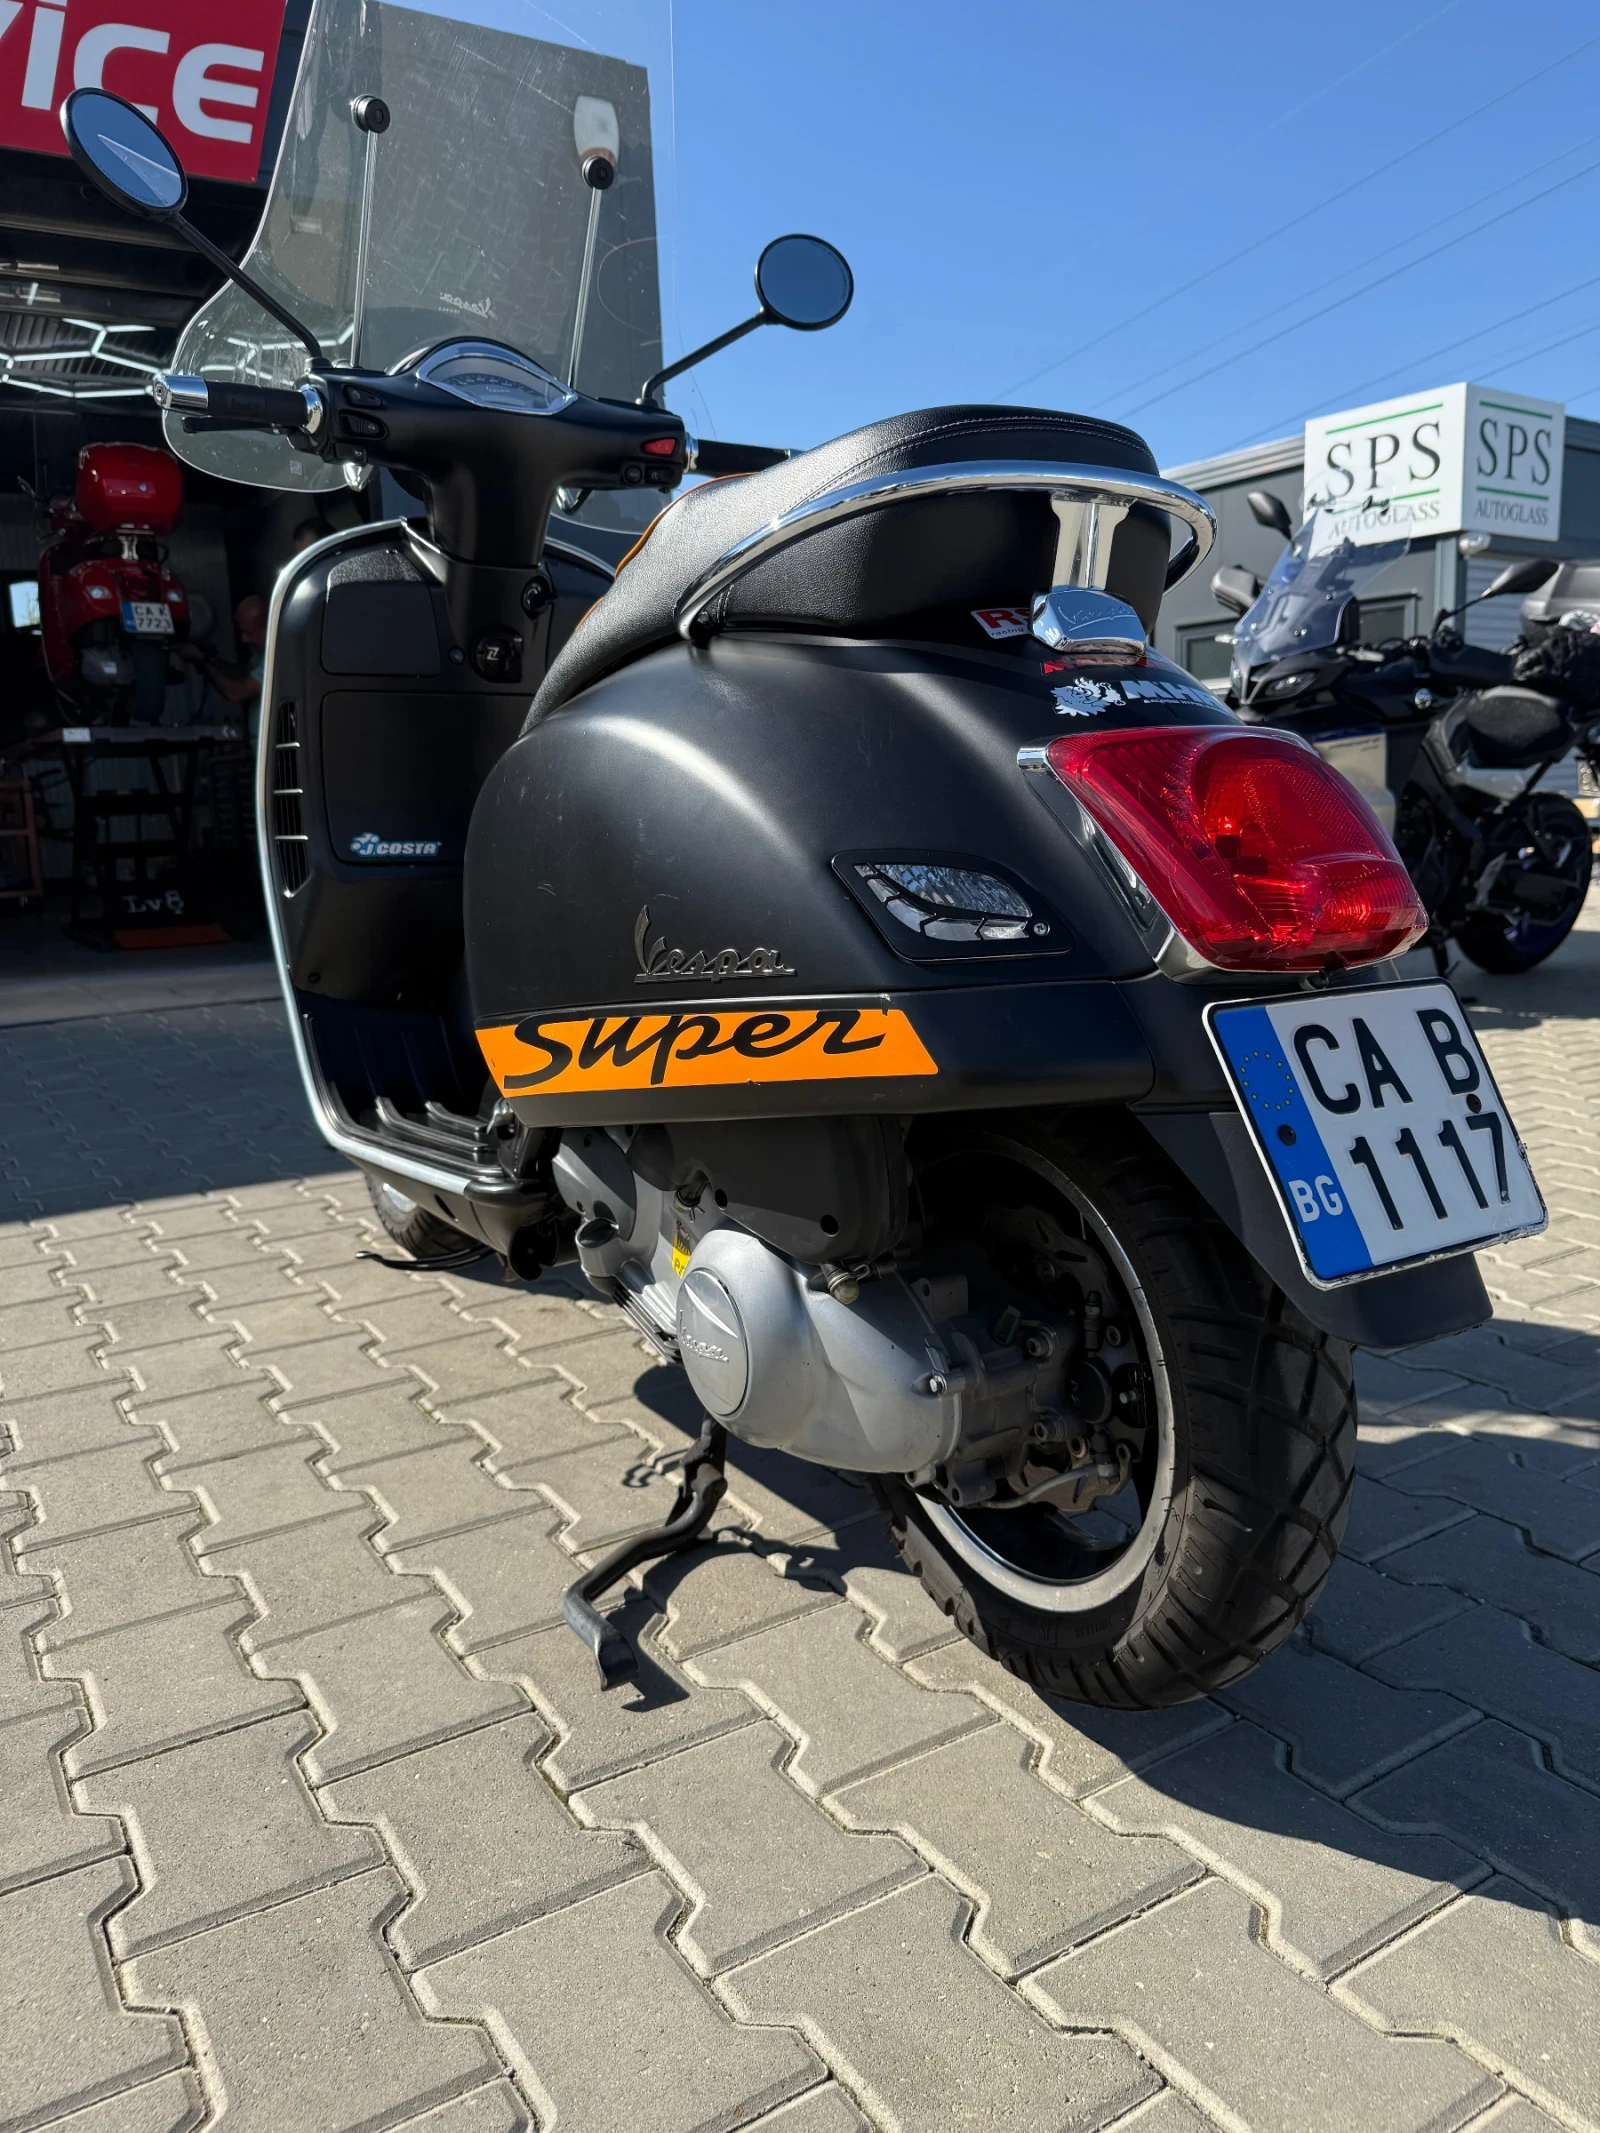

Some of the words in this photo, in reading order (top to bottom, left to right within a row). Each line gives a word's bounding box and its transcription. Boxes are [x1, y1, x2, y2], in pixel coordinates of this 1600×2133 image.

[1325, 420, 1441, 498] SPS
[1477, 418, 1552, 486] SPS
[1328, 501, 1440, 540] AUTOGLASS
[1475, 501, 1548, 526] AUTOGLASS
[991, 628, 1025, 637] racing
[634, 905, 798, 984] Vespa
[1292, 1017, 1413, 1115] CA
[1416, 1008, 1481, 1096] B
[1288, 1175, 1343, 1223] BG
[1350, 1111, 1511, 1231] 1117
